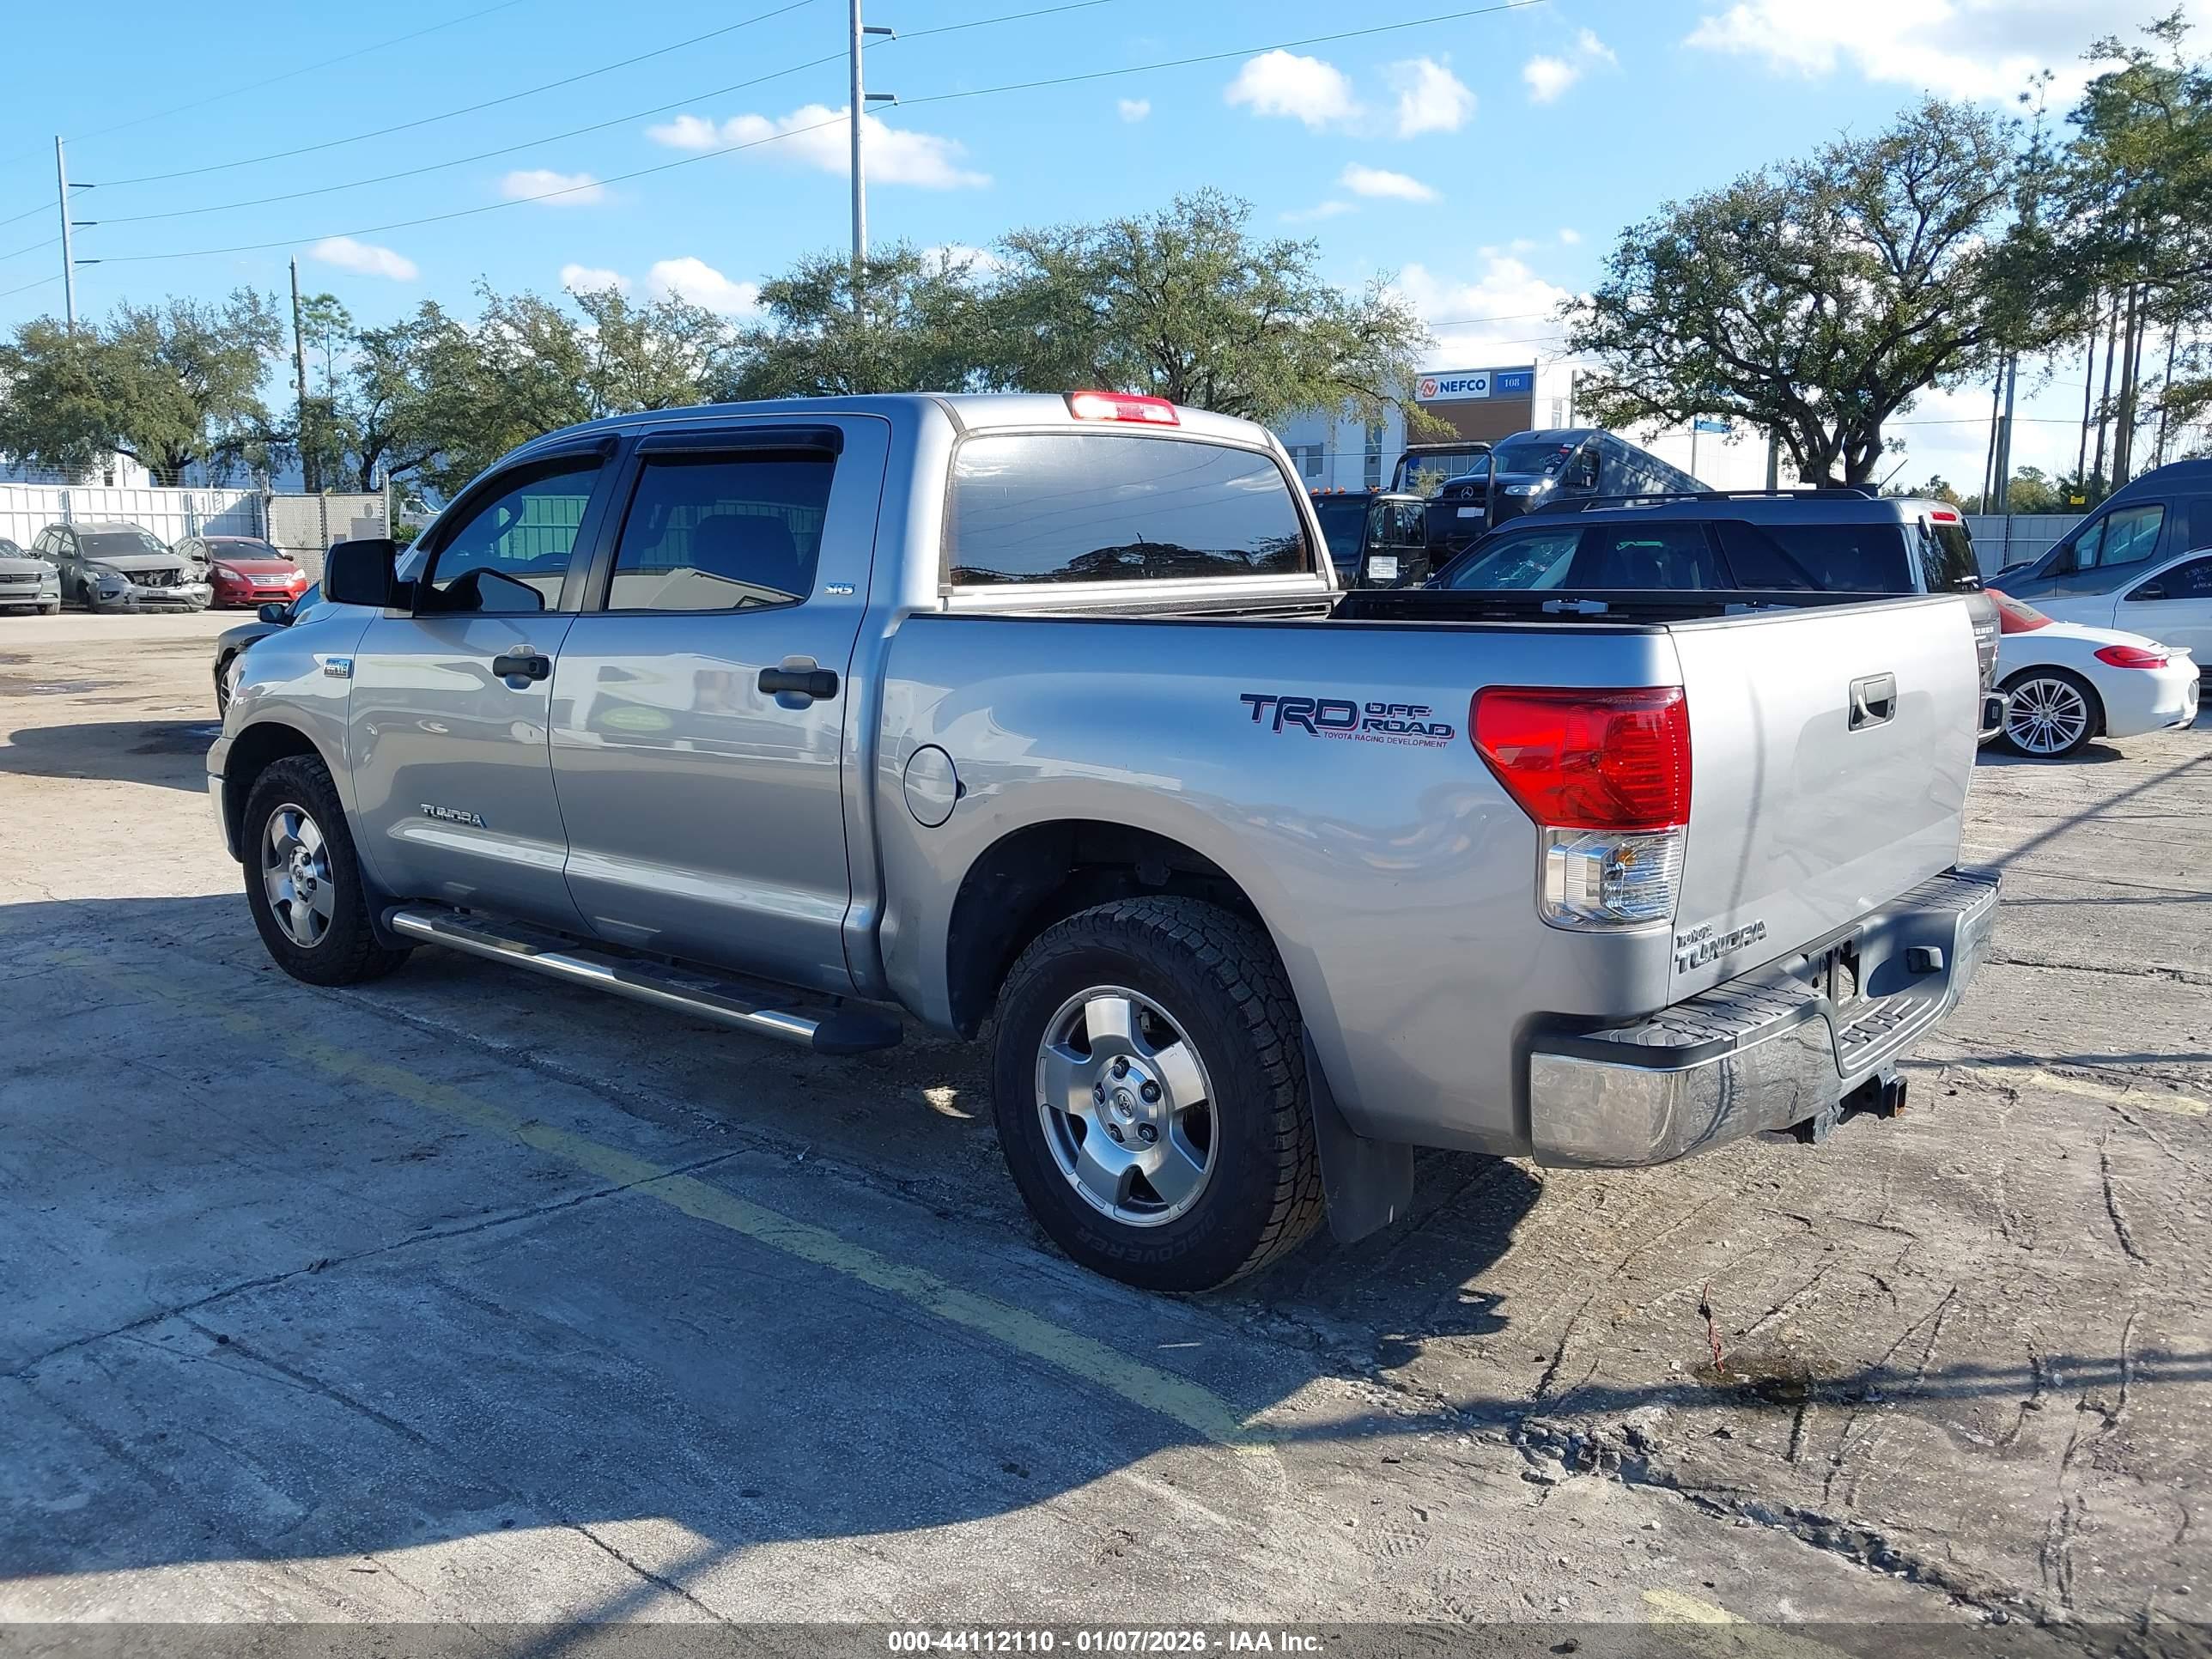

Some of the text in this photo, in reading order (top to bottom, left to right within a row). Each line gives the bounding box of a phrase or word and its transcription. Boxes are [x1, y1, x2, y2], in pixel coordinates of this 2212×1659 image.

[1439, 379, 1486, 393] NEFCO
[1504, 378, 1521, 388] 108
[1240, 693, 1360, 738] TRD
[1364, 702, 1432, 720] OFF
[1361, 718, 1455, 739] ROAD
[1323, 731, 1448, 749] TOYOTA RACING DEVELOPMENT
[419, 802, 487, 830] TUNDRA
[1674, 918, 1768, 975] TUNDRA
